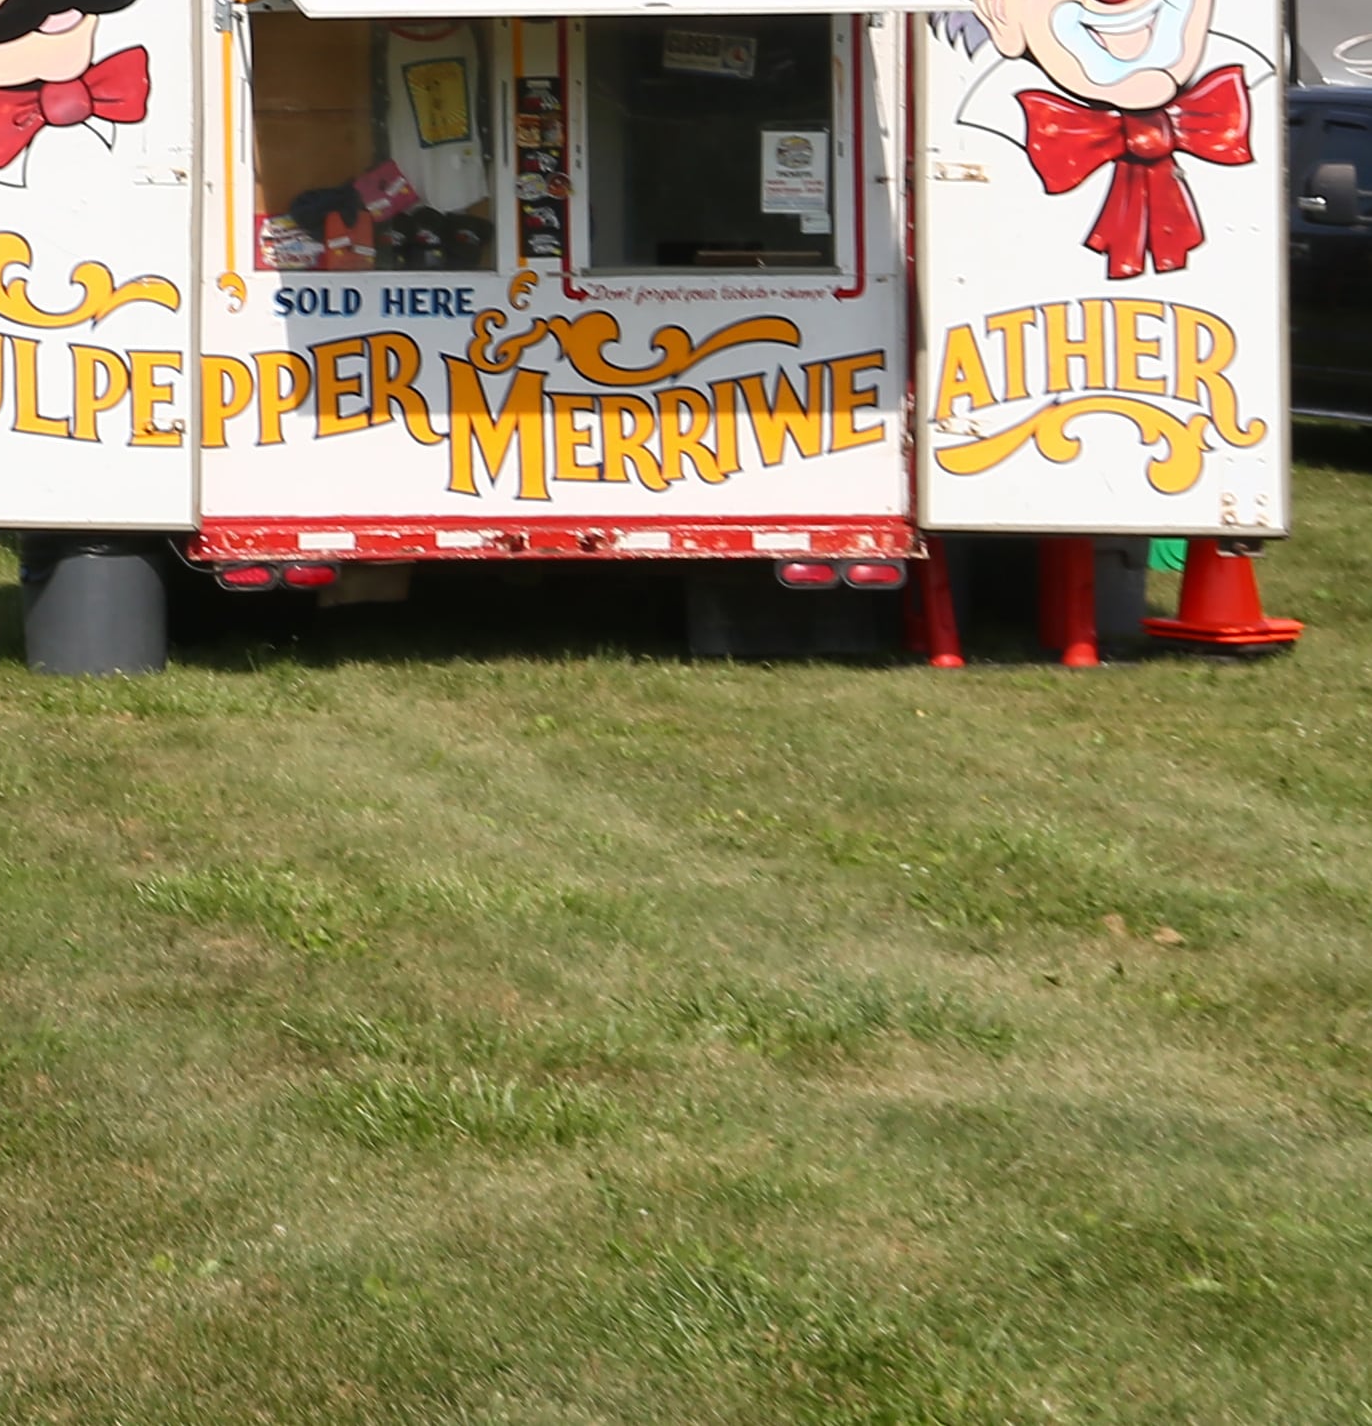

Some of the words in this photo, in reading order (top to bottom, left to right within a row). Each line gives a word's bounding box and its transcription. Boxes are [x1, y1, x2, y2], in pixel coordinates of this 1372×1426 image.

[273, 287, 362, 318] SOLD
[381, 286, 478, 317] HERE
[466, 308, 549, 374] &
